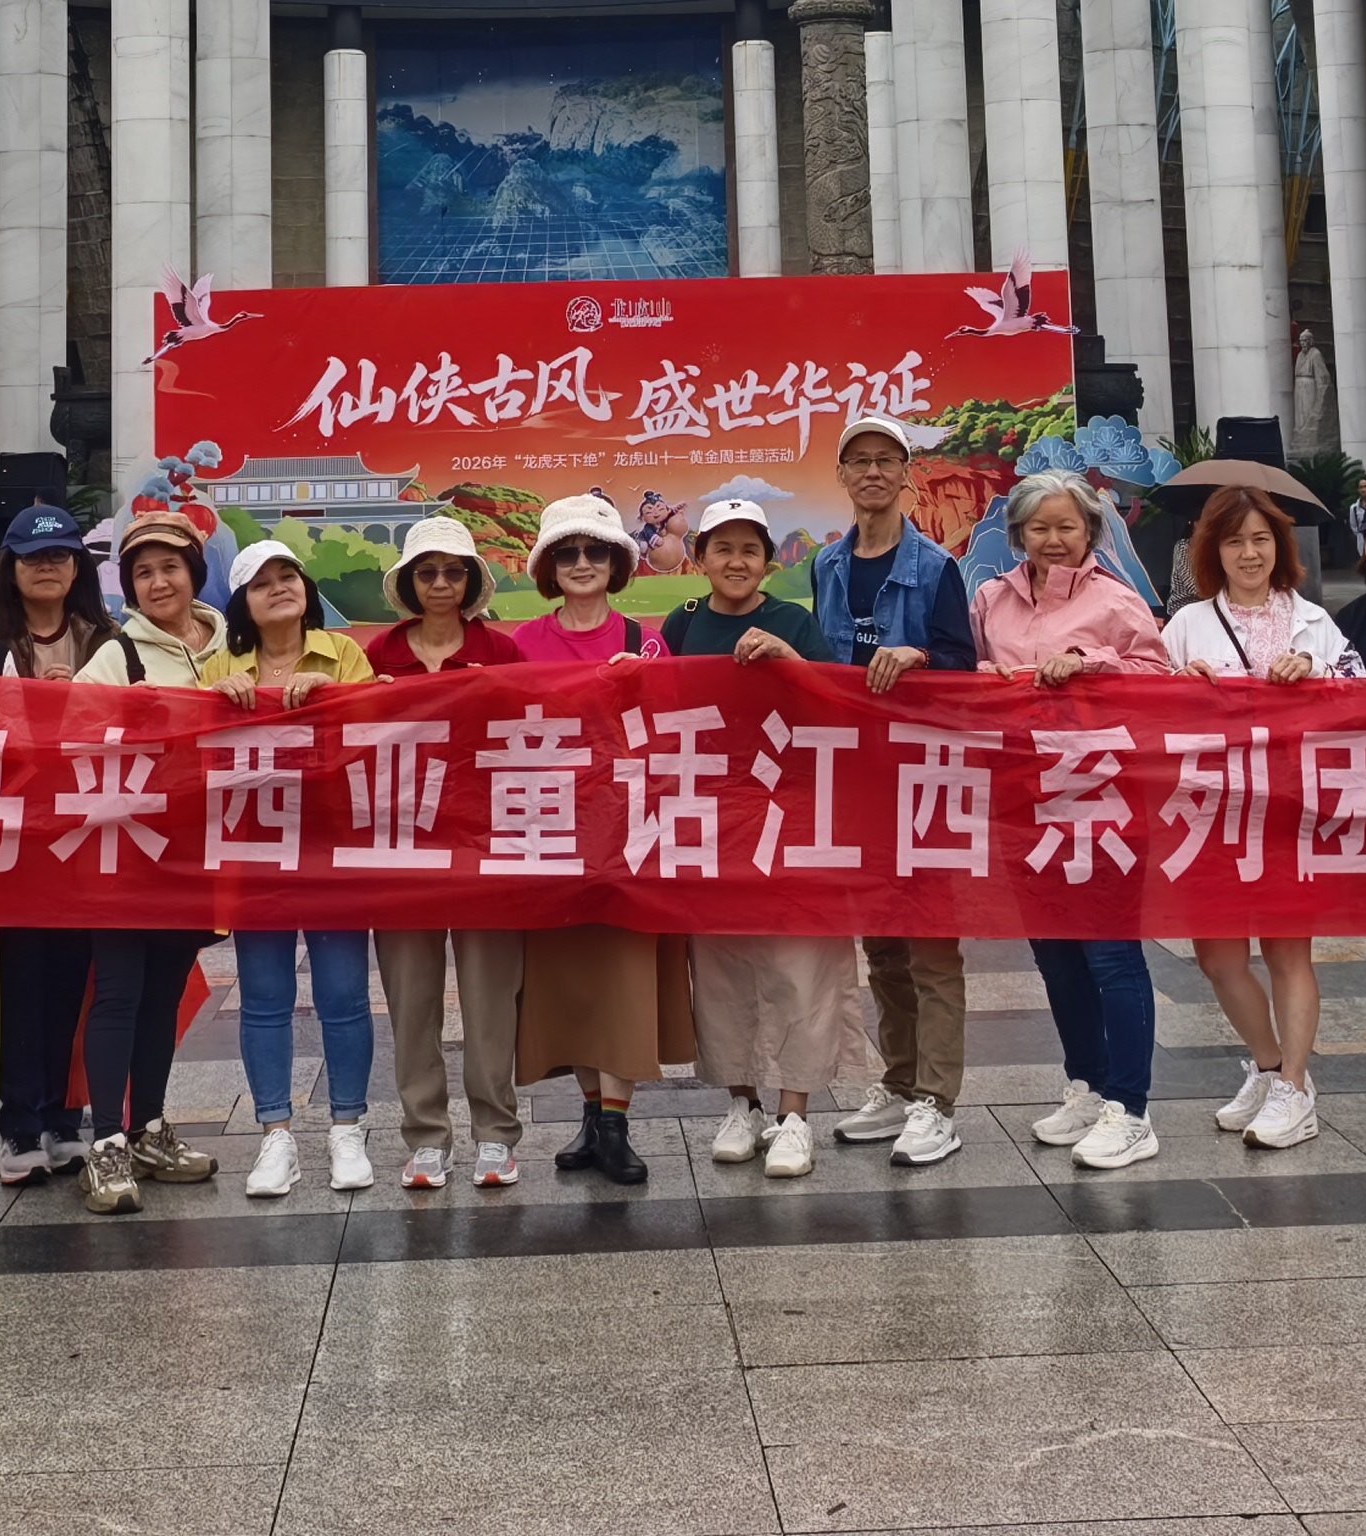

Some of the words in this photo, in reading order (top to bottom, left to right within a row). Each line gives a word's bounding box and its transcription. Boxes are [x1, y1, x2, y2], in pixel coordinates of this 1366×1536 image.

[275, 347, 619, 438] 仙侠古风
[625, 350, 951, 460] 盛世华诞
